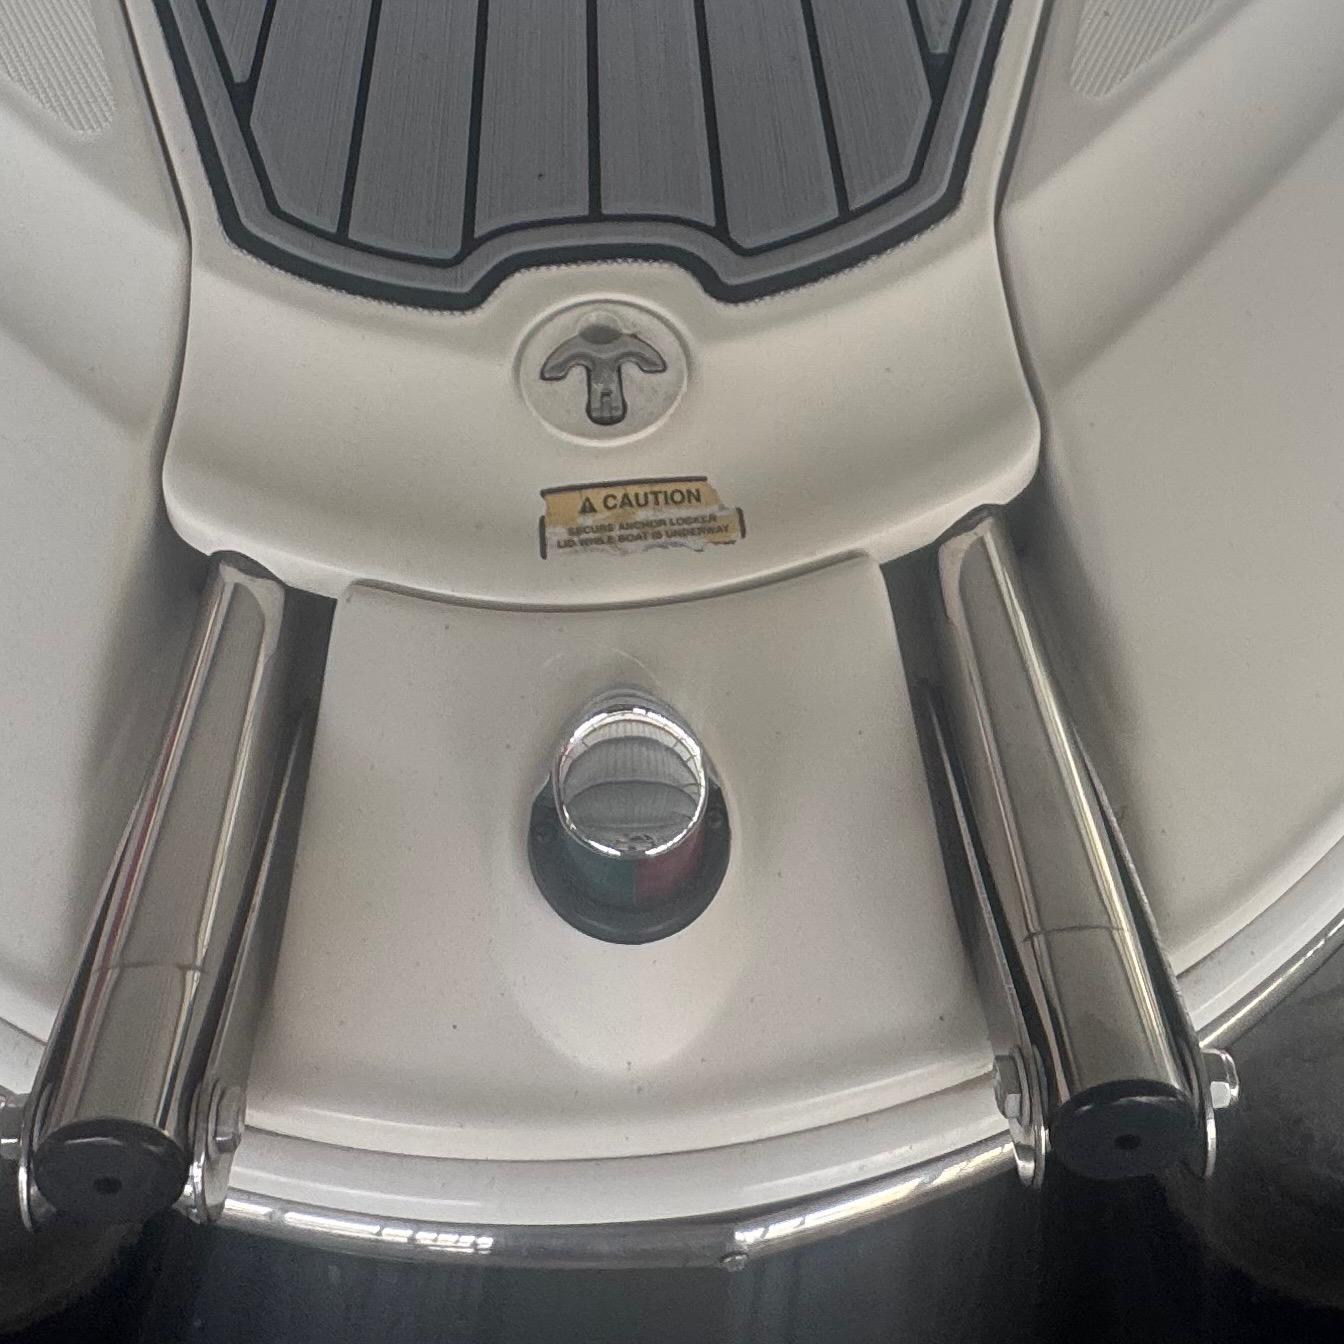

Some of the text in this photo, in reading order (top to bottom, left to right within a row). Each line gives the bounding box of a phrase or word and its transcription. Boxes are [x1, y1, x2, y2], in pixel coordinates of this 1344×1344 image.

[602, 488, 702, 511] CAUTION
[618, 532, 649, 543] BOAT
[664, 523, 729, 539] UNDERWAY
